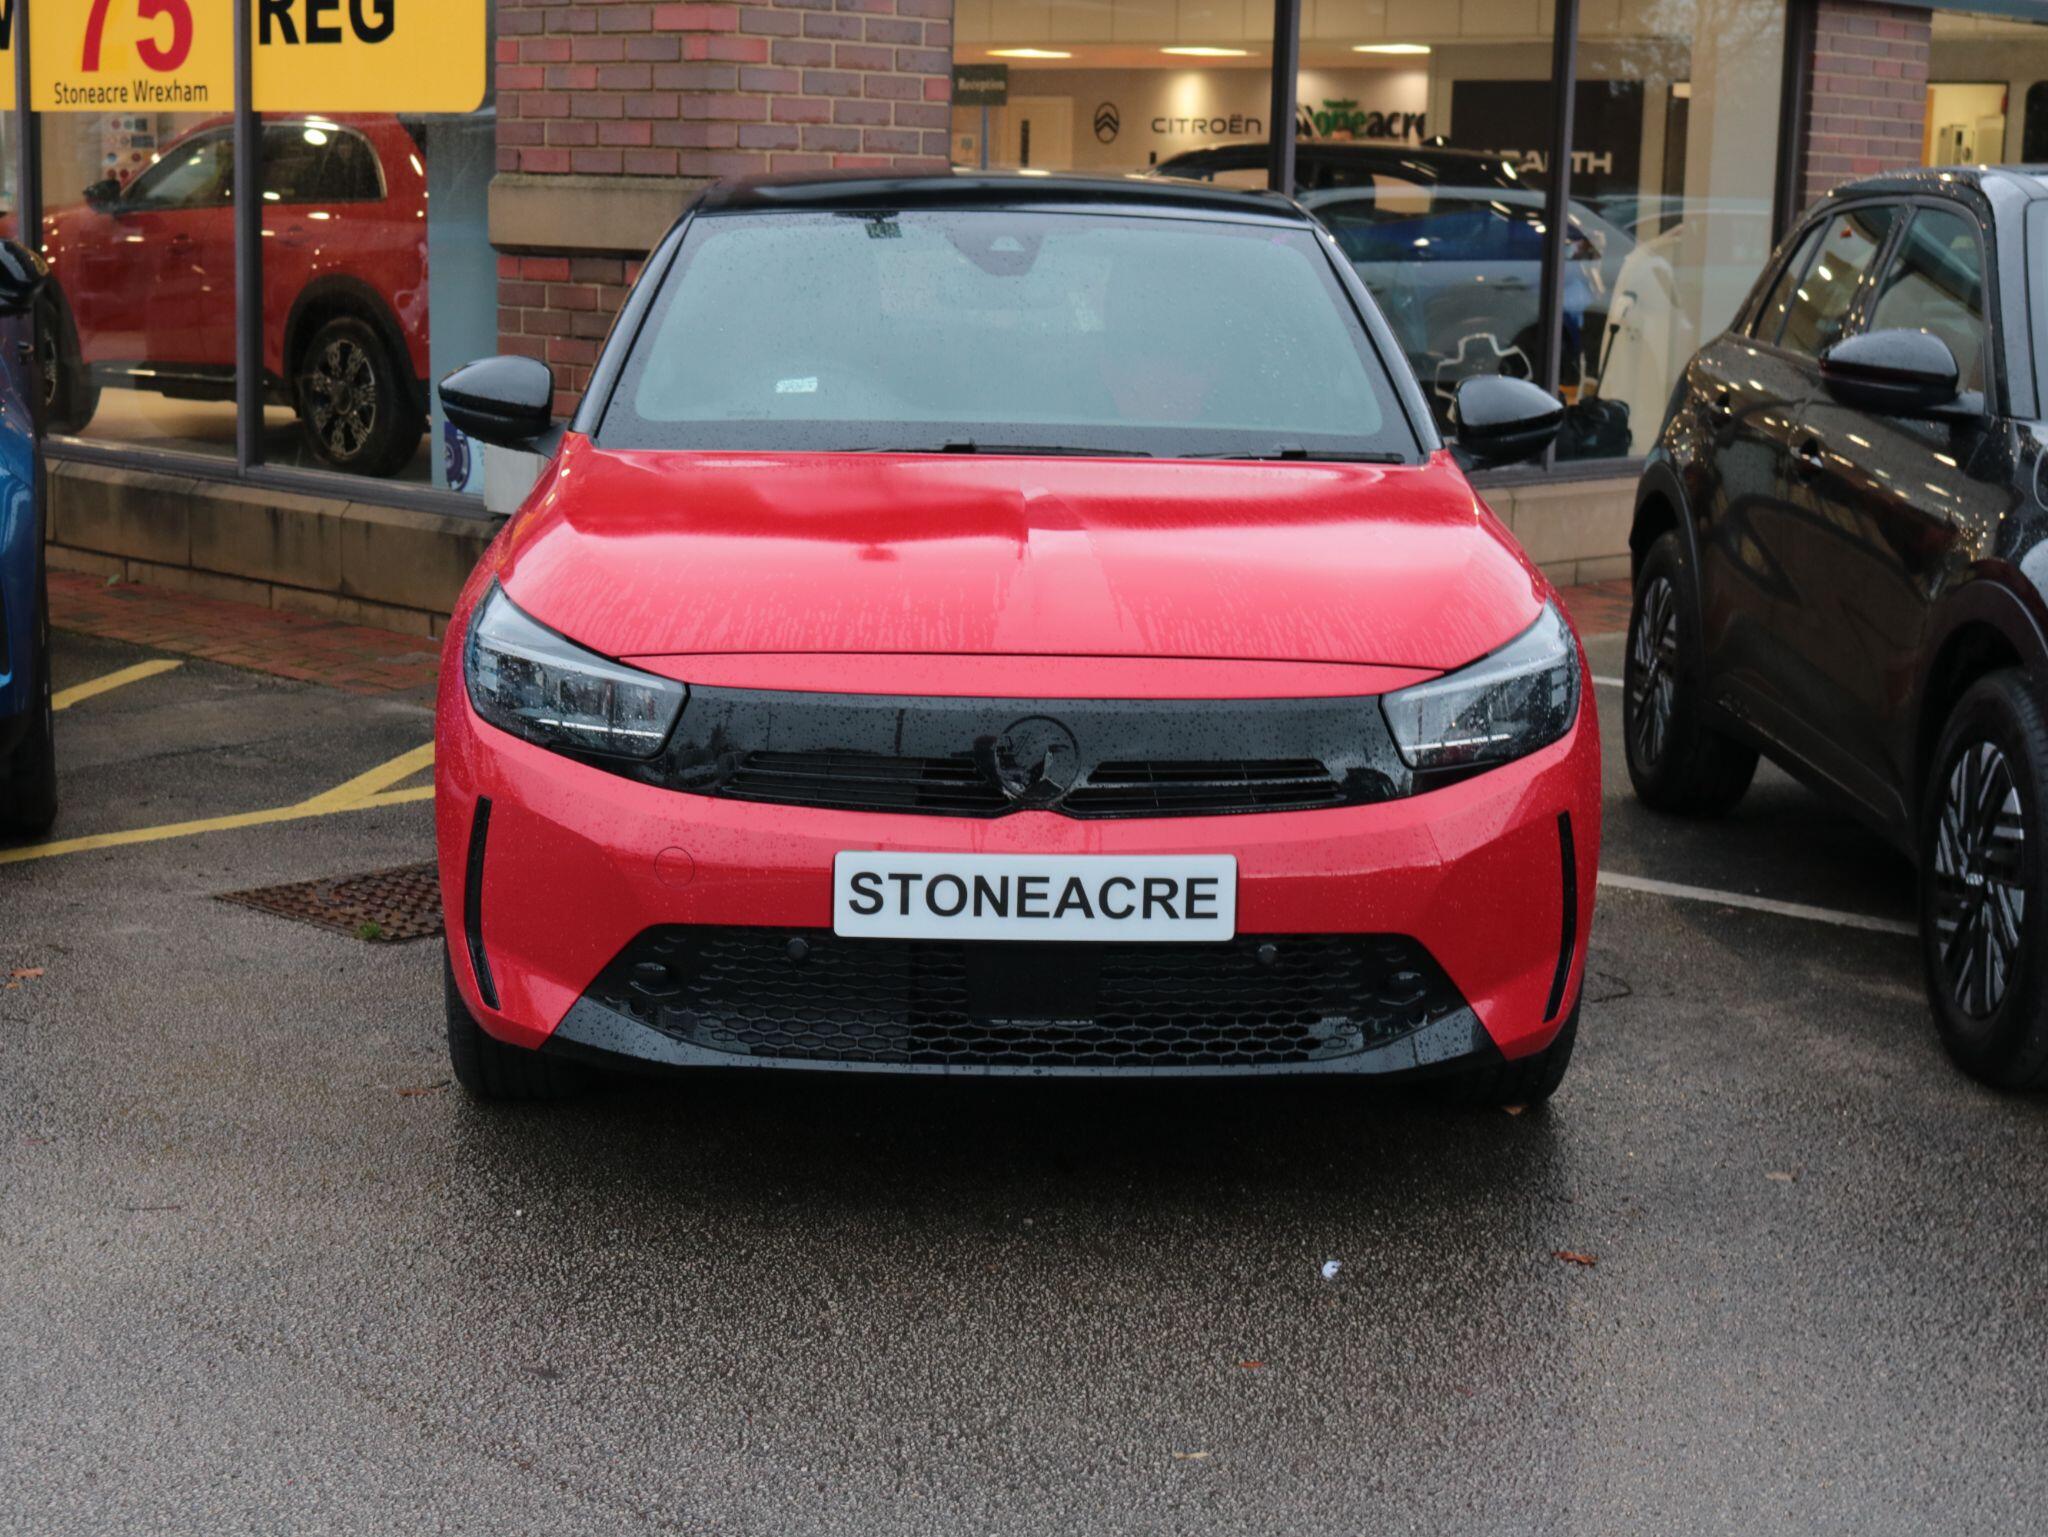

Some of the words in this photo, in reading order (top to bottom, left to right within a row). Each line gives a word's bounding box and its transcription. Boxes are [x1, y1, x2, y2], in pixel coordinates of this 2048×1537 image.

[82, 0, 194, 72] 75
[259, 0, 394, 45] REG
[54, 81, 128, 104] Stoneacre
[133, 78, 208, 103] Wrexham
[848, 872, 1219, 920] STONEACRE
